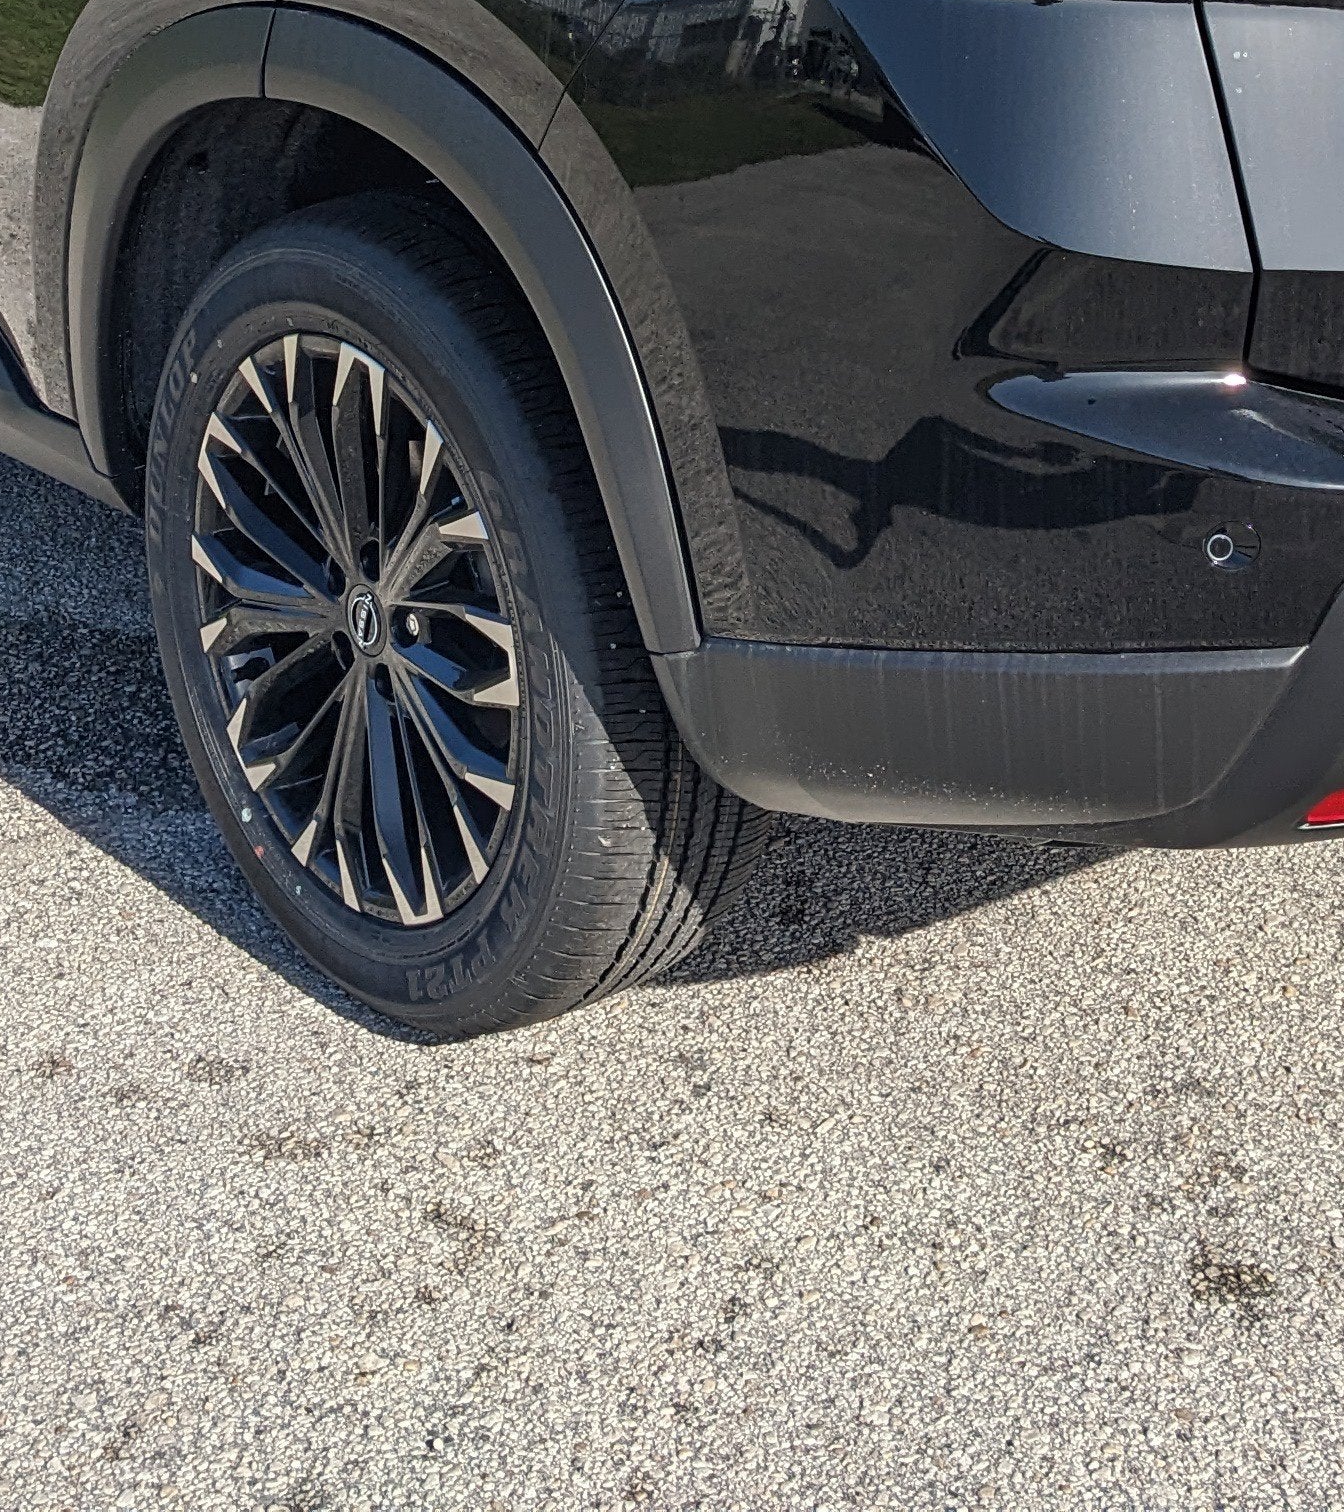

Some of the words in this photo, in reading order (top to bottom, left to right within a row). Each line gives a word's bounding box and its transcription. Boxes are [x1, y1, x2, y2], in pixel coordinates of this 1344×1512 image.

[149, 330, 197, 548] DUNLOP
[357, 593, 373, 649] NISSAN
[408, 931, 496, 1001] PT21
